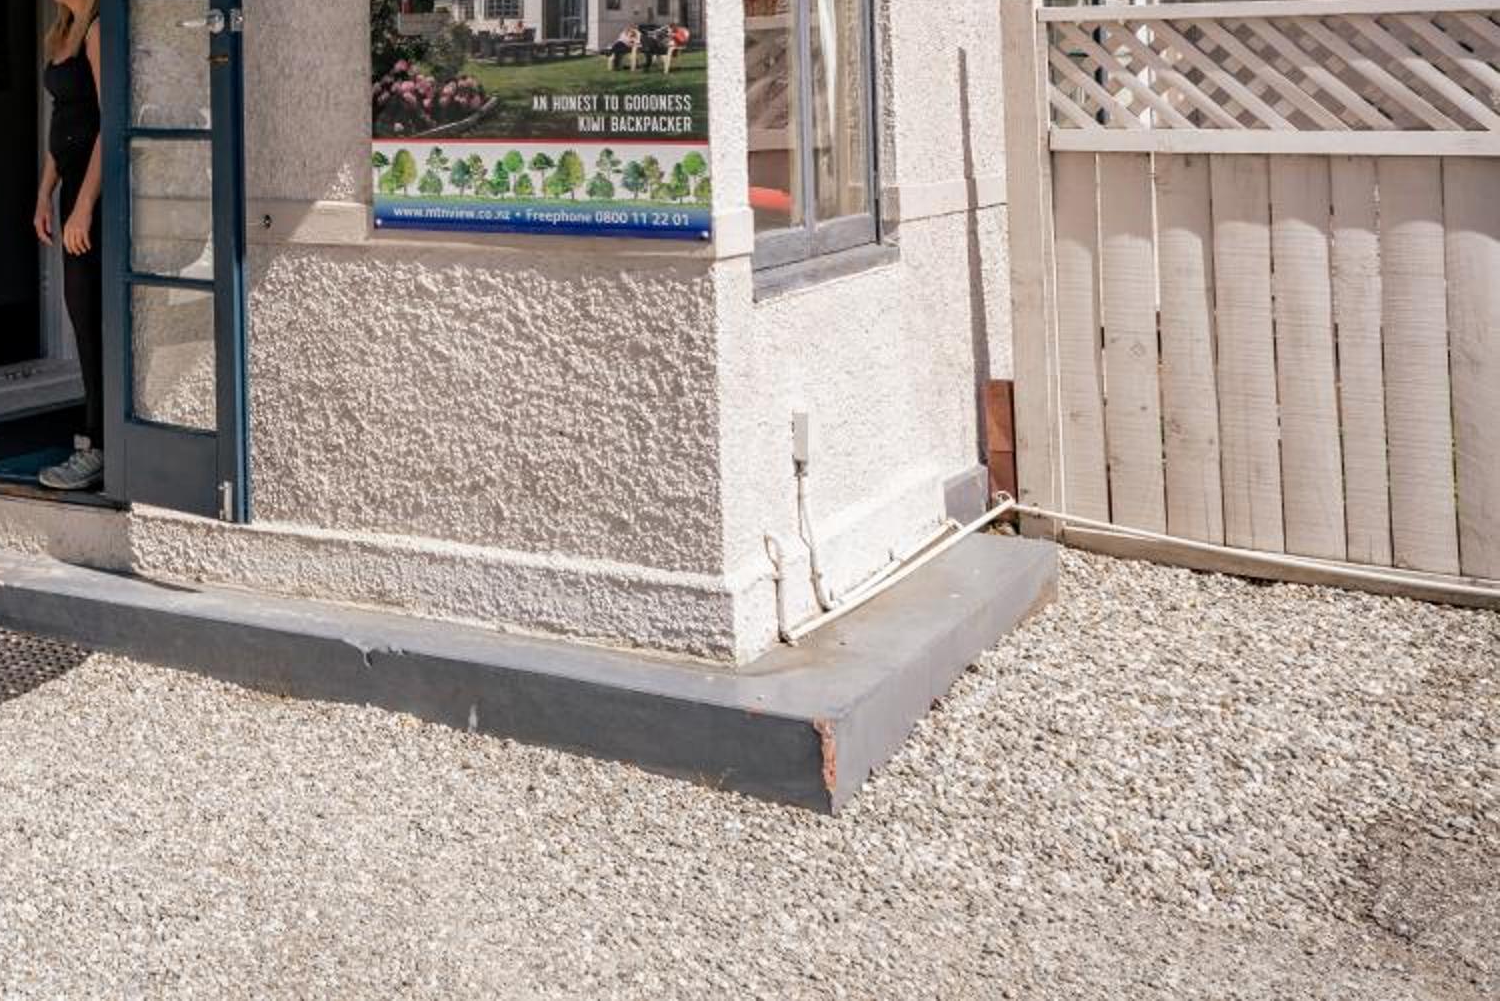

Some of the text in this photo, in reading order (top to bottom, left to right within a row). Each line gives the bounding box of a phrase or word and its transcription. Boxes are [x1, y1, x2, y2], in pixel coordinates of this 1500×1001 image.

[532, 94, 693, 111] AN HONEST TO GOODNESS
[578, 116, 693, 132] KIWI BACKPACKER
[526, 208, 592, 225] Freephone
[595, 210, 629, 224] 0800
[632, 211, 647, 224] 11
[652, 212, 669, 226] 22
[672, 213, 690, 226] 01
